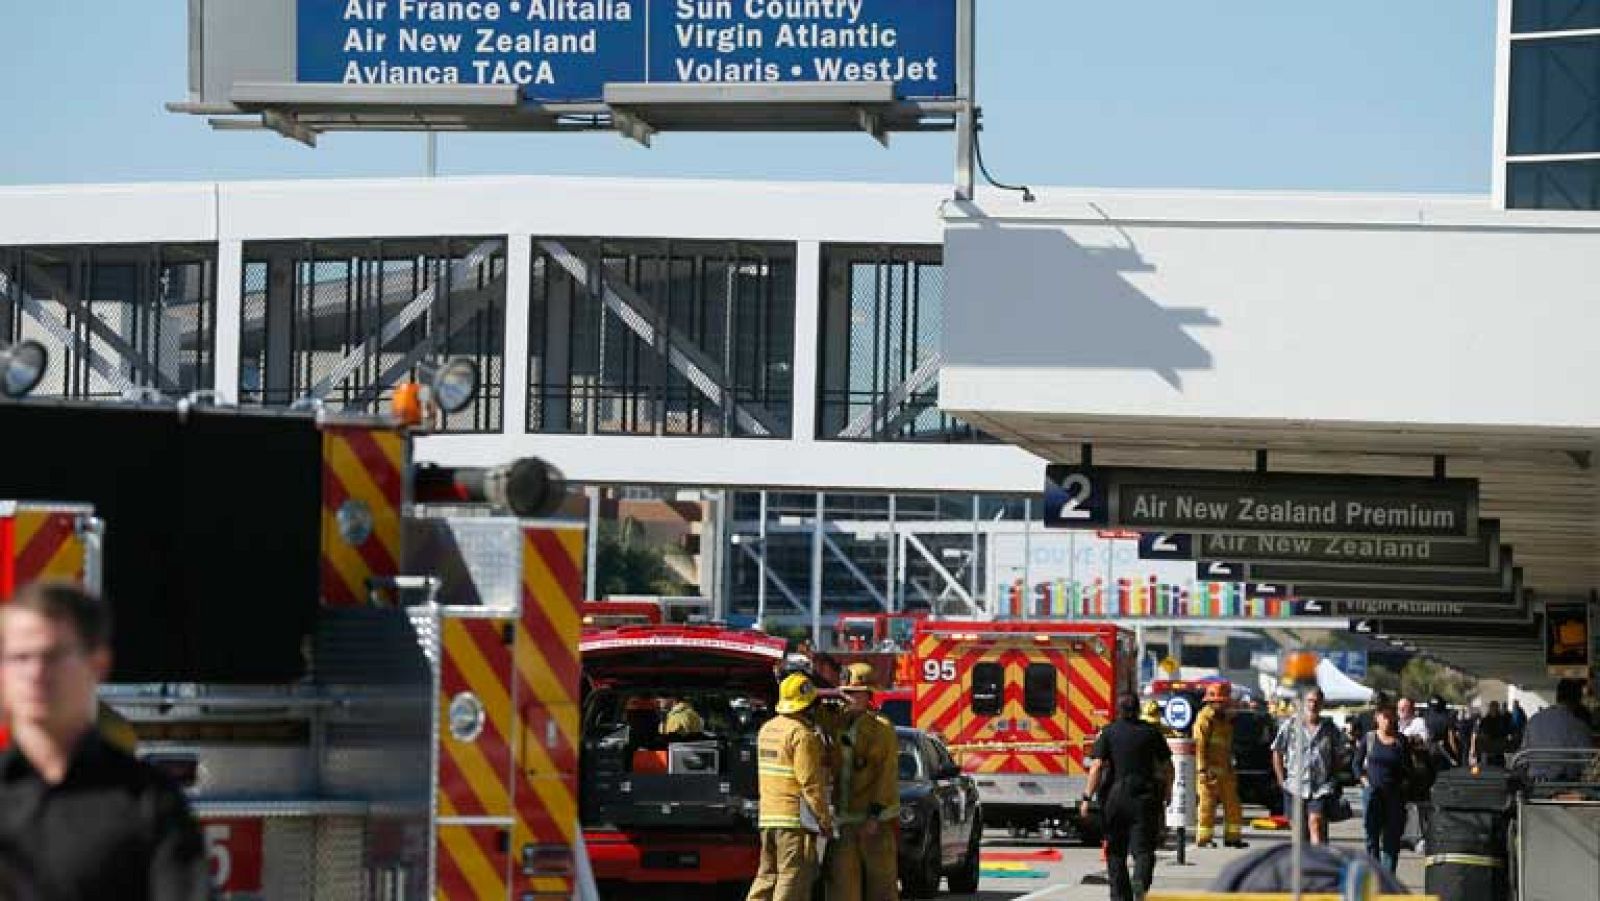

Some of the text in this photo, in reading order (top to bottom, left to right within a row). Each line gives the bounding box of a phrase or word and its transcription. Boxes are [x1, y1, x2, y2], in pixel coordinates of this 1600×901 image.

[343, 0, 632, 20] Air France Alitalia
[675, 0, 862, 23] Sun Country
[343, 28, 598, 52] Air New Zealand
[674, 22, 898, 52] Virgin Atlantic
[343, 60, 555, 84] Avianca TACA
[674, 57, 939, 81] Volaris WestJet
[1059, 473, 1093, 518] 2
[1132, 493, 1455, 529] Air New Zealand Premium
[1209, 534, 1431, 558] Air New Zealand
[923, 659, 957, 682] 95
